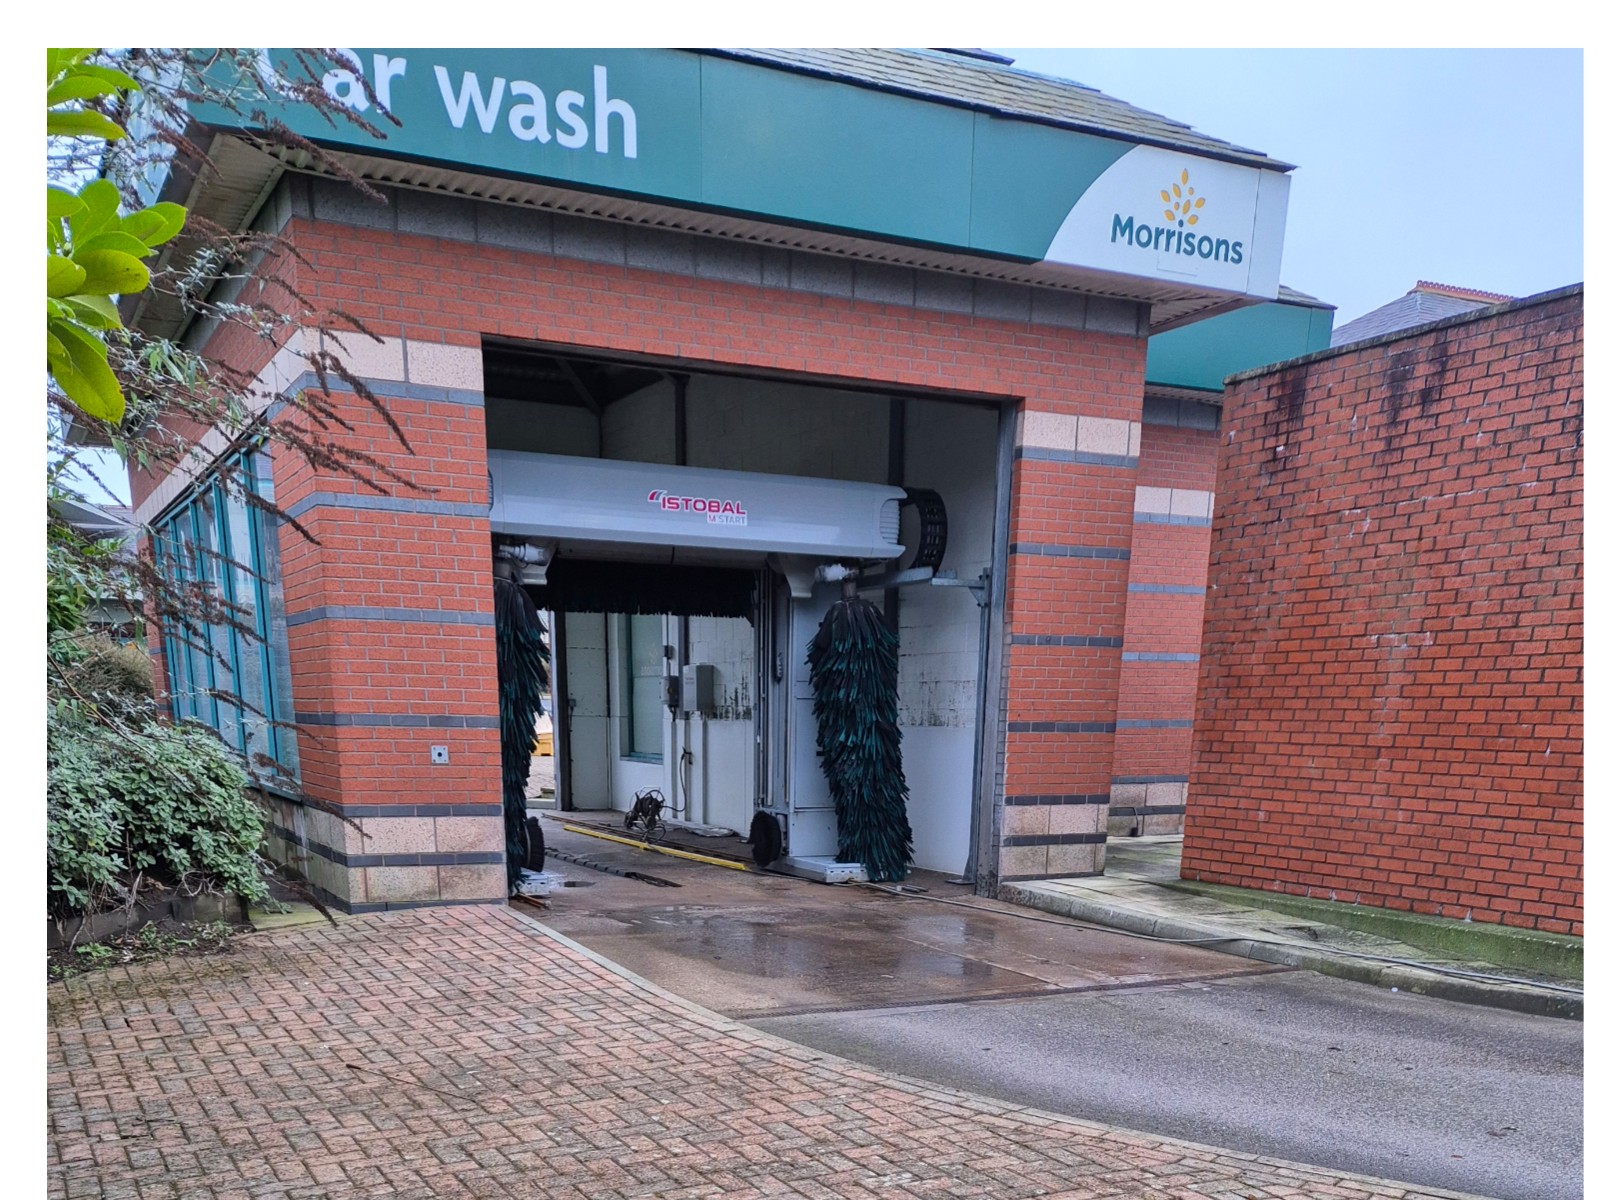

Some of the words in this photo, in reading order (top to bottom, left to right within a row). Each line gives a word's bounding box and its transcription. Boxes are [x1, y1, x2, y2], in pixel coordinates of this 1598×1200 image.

[434, 65, 638, 159] wash
[1110, 213, 1243, 265] Morrisons
[661, 496, 746, 515] ISTOBAL
